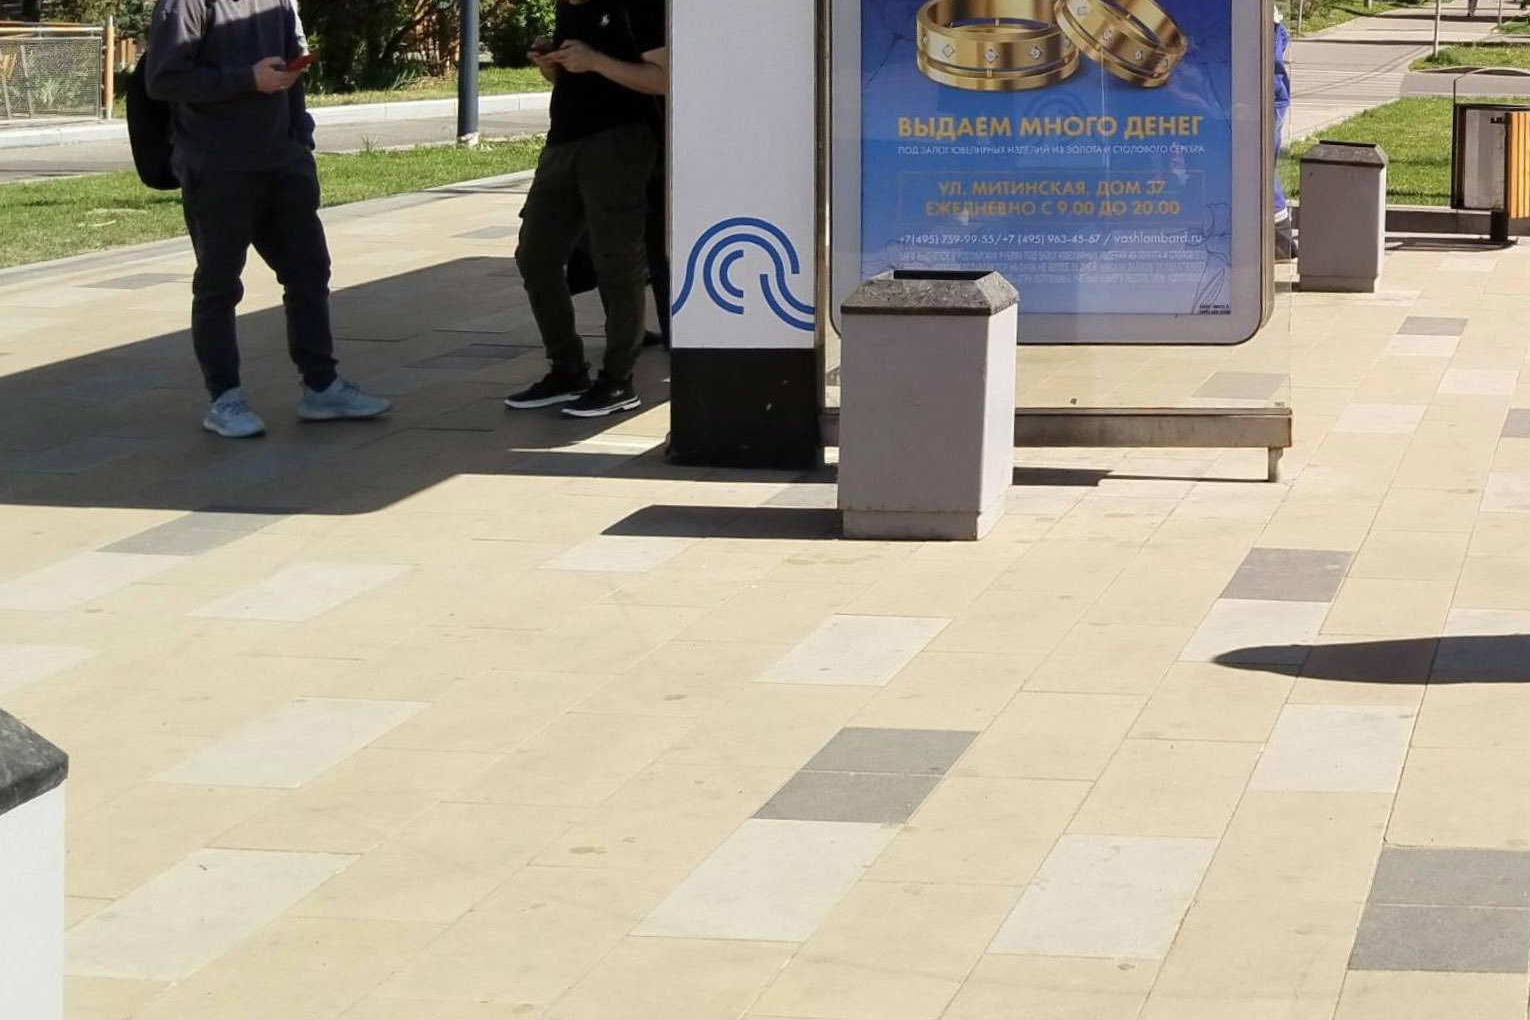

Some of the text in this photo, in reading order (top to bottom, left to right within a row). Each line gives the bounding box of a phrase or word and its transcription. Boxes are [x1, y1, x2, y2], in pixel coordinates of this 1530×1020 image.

[898, 115, 1204, 141] ВЫДАЕМ МНОГО ДЕНЕГ
[898, 146, 918, 155] ПОД
[1097, 181, 1141, 197] ДОМ
[1146, 181, 1166, 195] 37
[925, 201, 1036, 218] ЕЖЕДНЕВНО
[1042, 201, 1053, 215] С
[1099, 201, 1127, 217] ДО
[1114, 232, 1203, 245] vashlombard.ru
